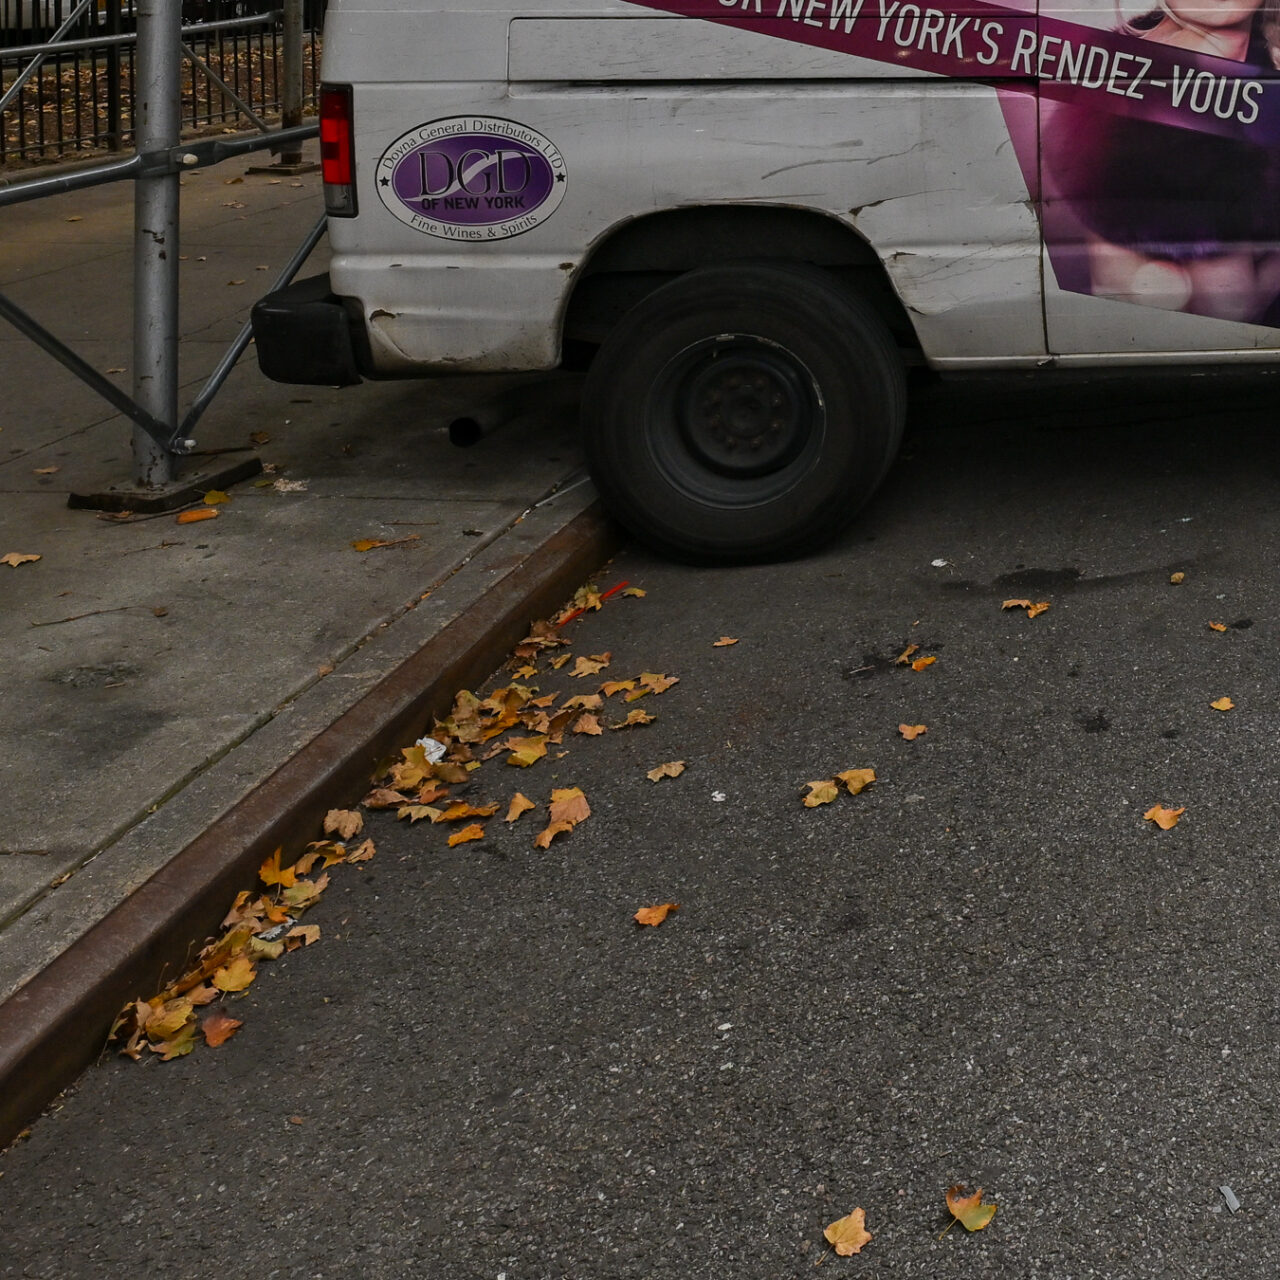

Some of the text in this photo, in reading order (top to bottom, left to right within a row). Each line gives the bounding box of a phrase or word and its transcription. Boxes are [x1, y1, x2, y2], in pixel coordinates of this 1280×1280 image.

[1010, 28, 1265, 124] RENDEZ-VOUS
[382, 119, 564, 170] Doyna General Distributors LTD
[418, 148, 532, 197] DGD
[410, 214, 538, 239] Fine Wines & Spirits
[421, 195, 526, 211] OF NEW YORK
